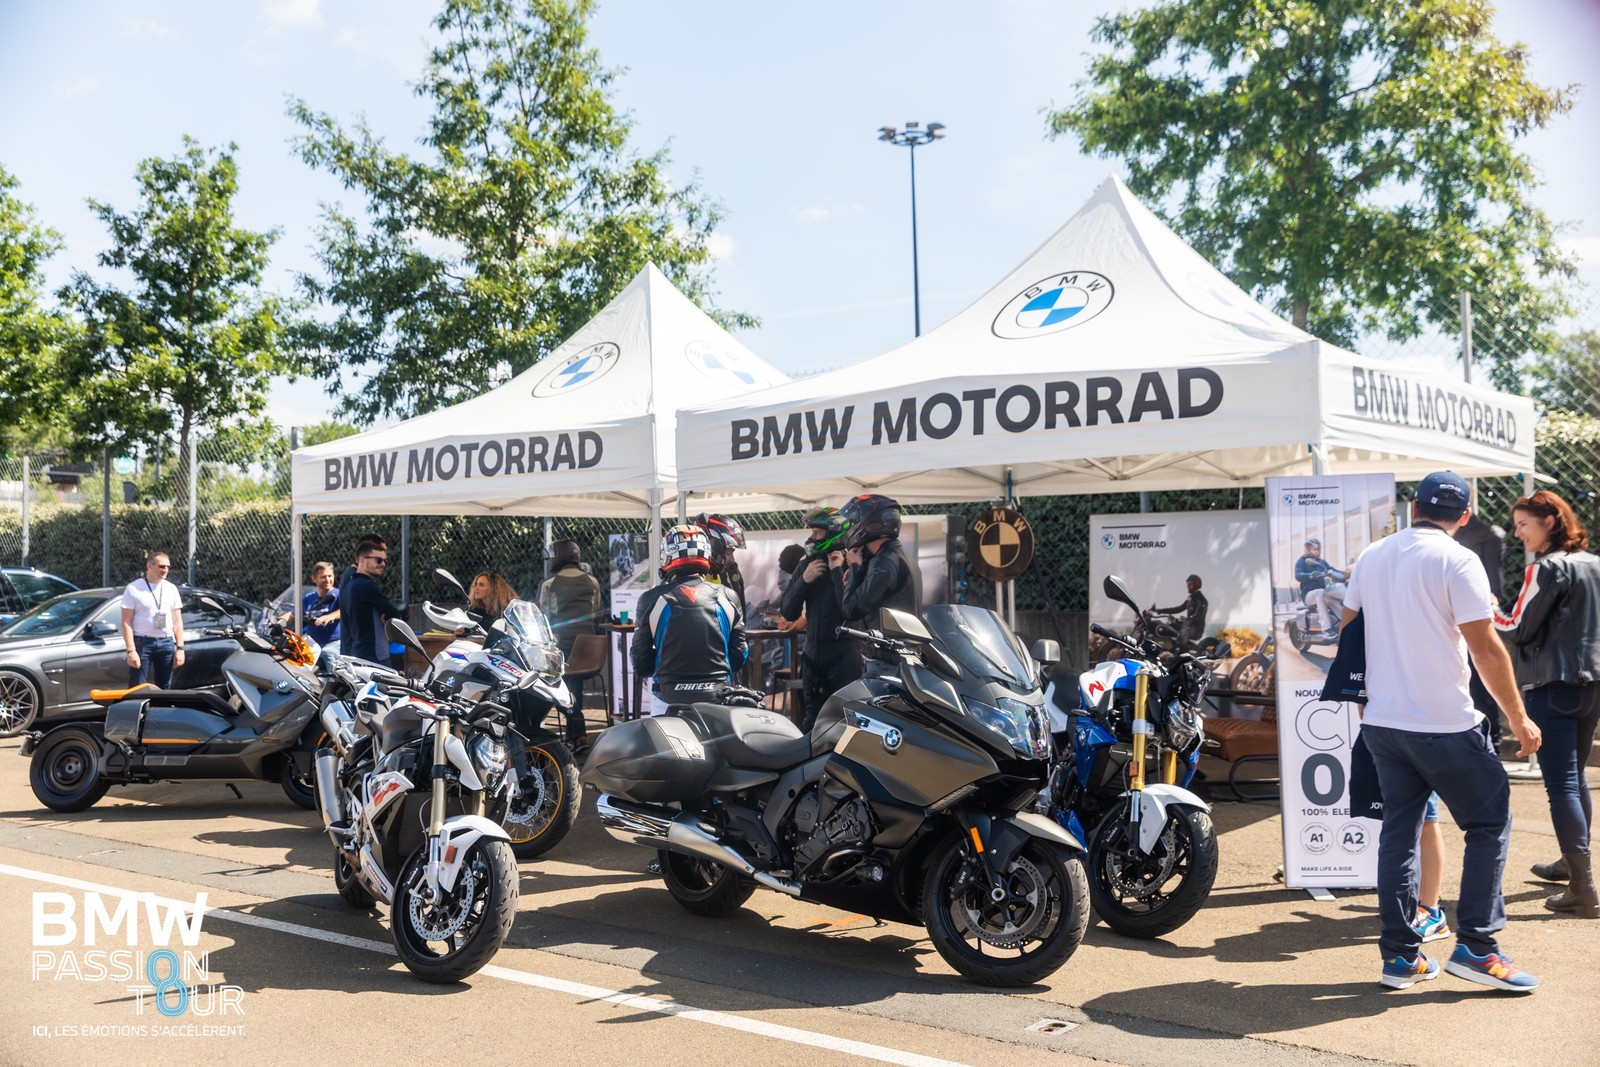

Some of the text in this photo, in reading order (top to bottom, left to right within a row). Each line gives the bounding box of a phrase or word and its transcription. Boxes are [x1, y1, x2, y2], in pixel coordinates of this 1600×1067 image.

[1024, 275, 1106, 299] BMW
[731, 366, 1224, 461] BMW MOTORRAD
[1352, 366, 1517, 449] BMW MOTORRAD
[324, 430, 604, 491] BMW MOTORRAD
[973, 510, 1027, 534] BMW
[1118, 533, 1141, 541] BMW
[1118, 541, 1167, 549] MOTORRAD
[674, 682, 716, 691] DAINESE
[1295, 698, 1353, 752] C
[1301, 808, 1329, 816] 100%
[1310, 833, 1324, 843] A1
[1342, 831, 1365, 845] A2
